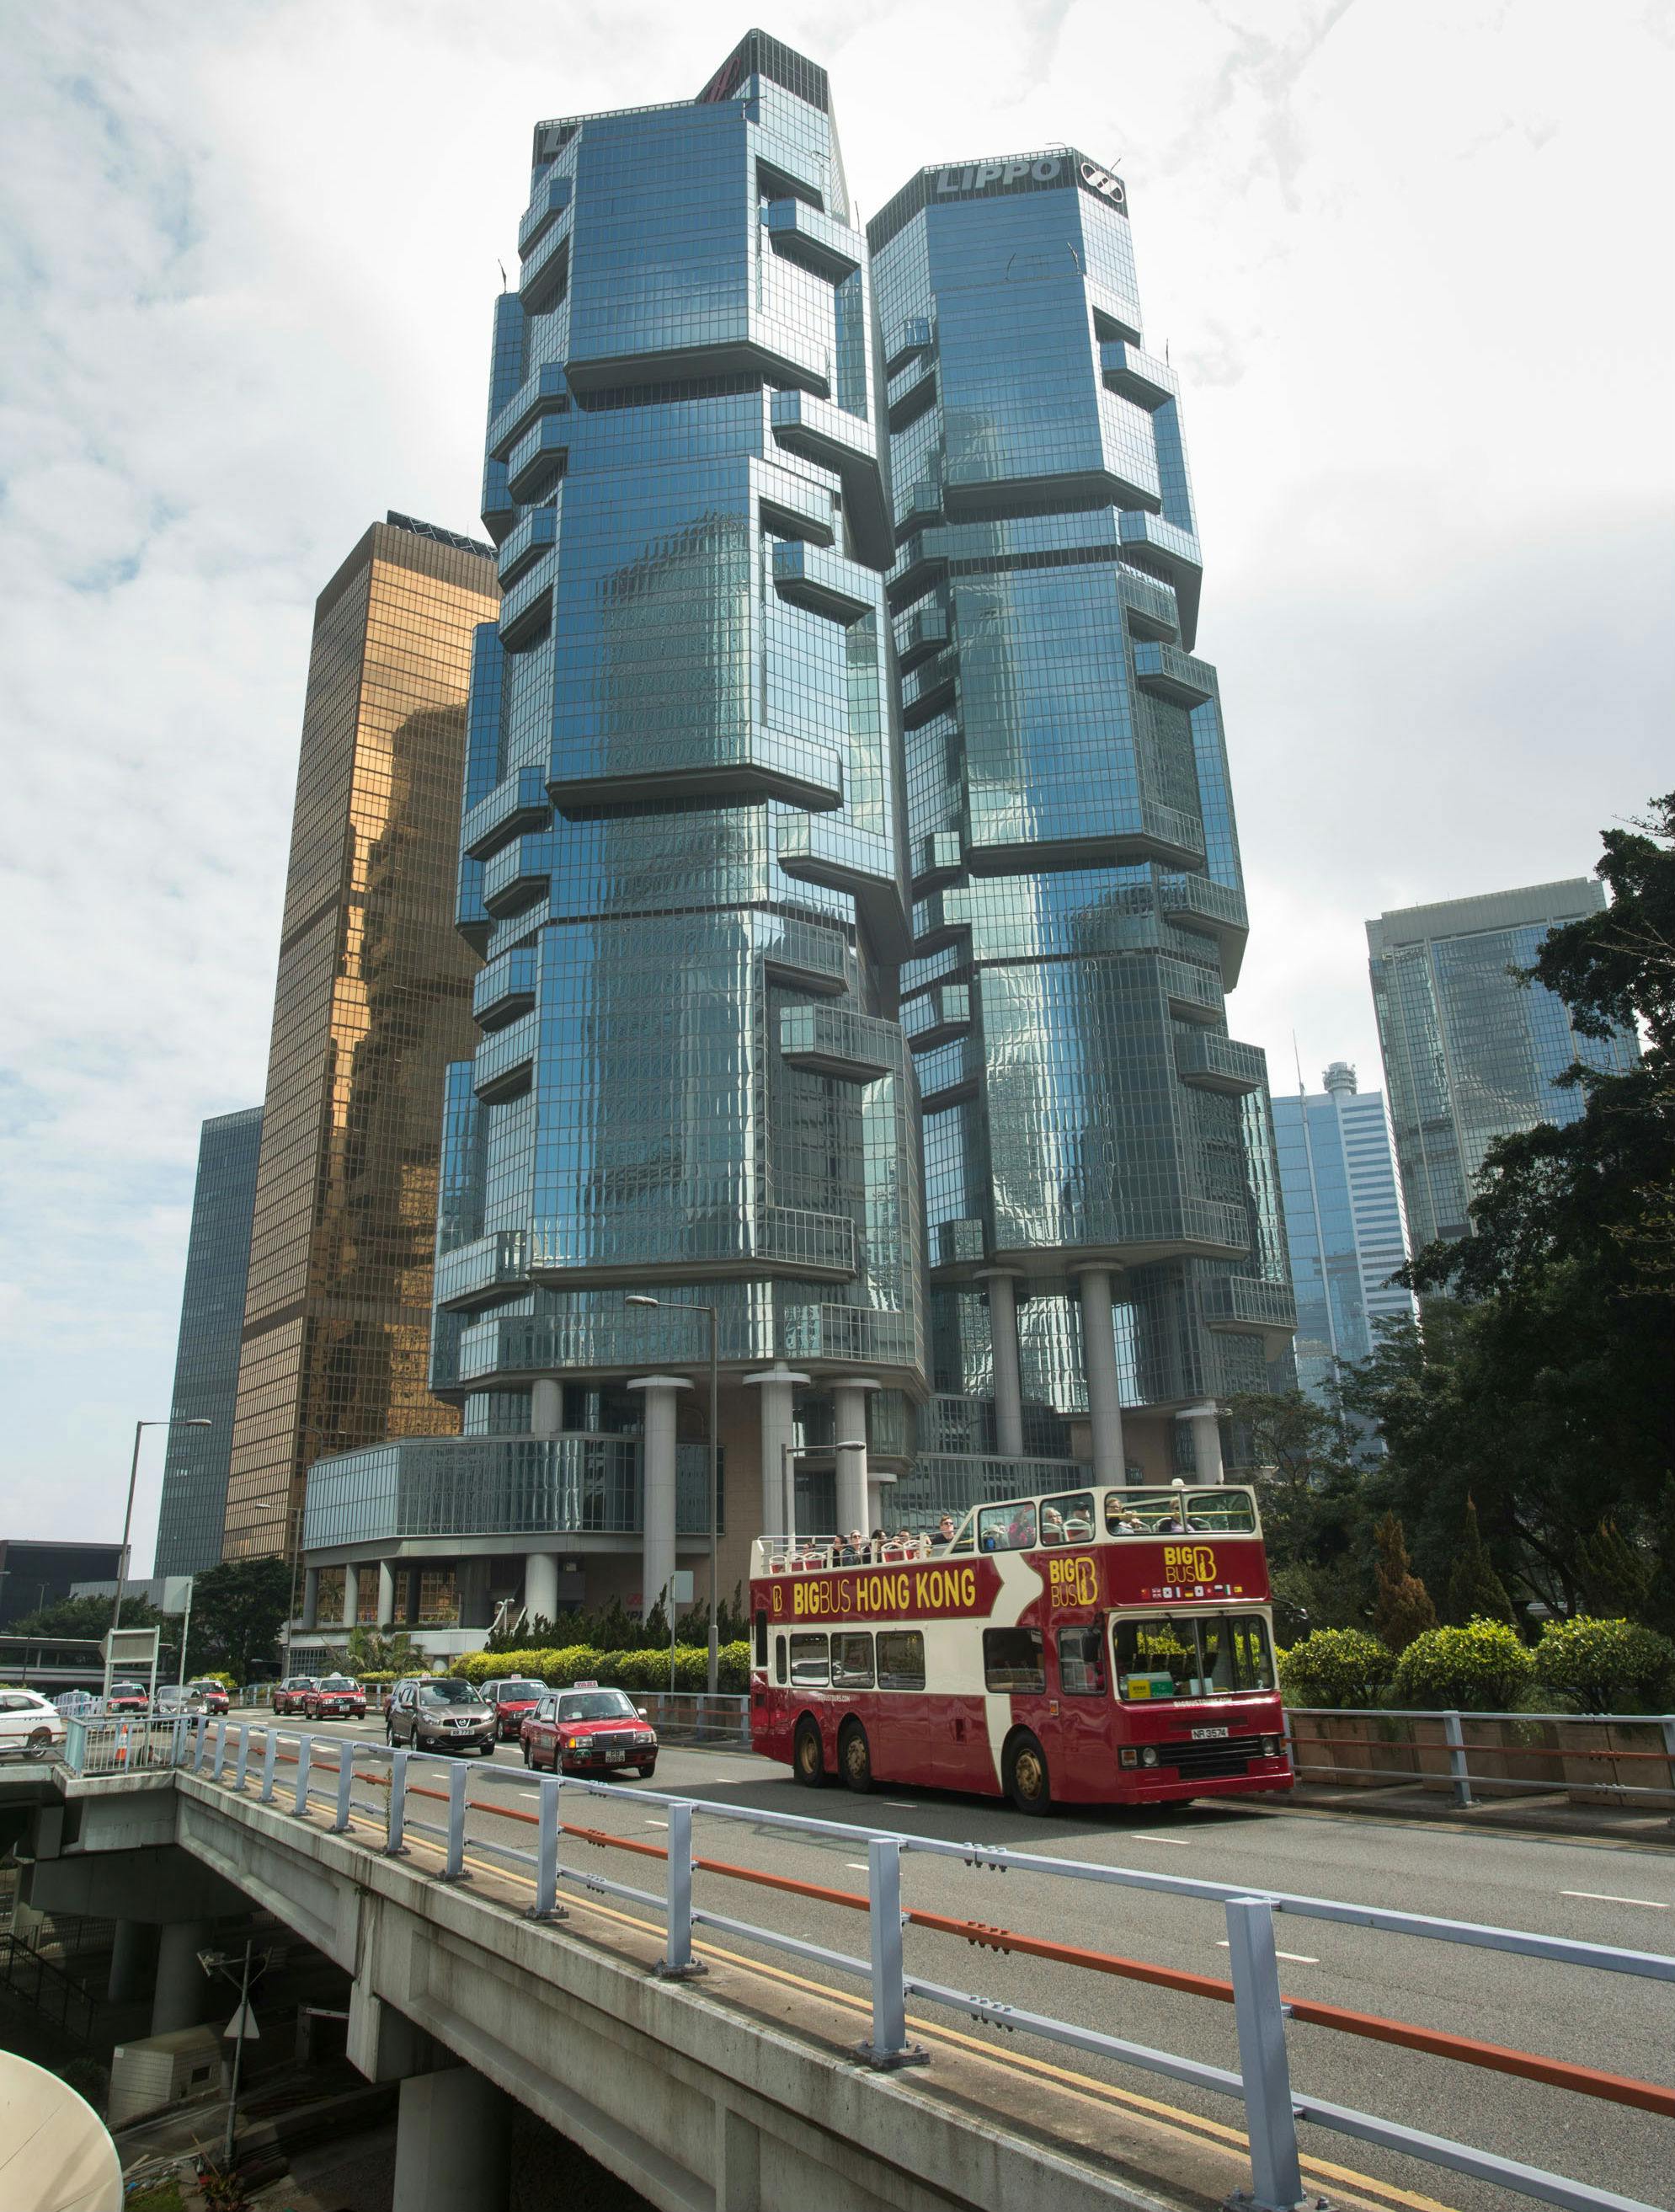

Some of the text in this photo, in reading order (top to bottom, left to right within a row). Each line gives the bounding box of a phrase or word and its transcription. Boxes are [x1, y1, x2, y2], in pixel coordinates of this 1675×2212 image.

[936, 157, 1060, 194] LIPPO
[1164, 1547, 1192, 1565] BIG
[1049, 1558, 1075, 1584] BIG
[1166, 1566, 1196, 1584] BUS
[856, 1574, 910, 1611] HONG
[916, 1568, 975, 1608] KONG
[1052, 1584, 1078, 1607] BUS
[1193, 1728, 1226, 1739] NR 3574
